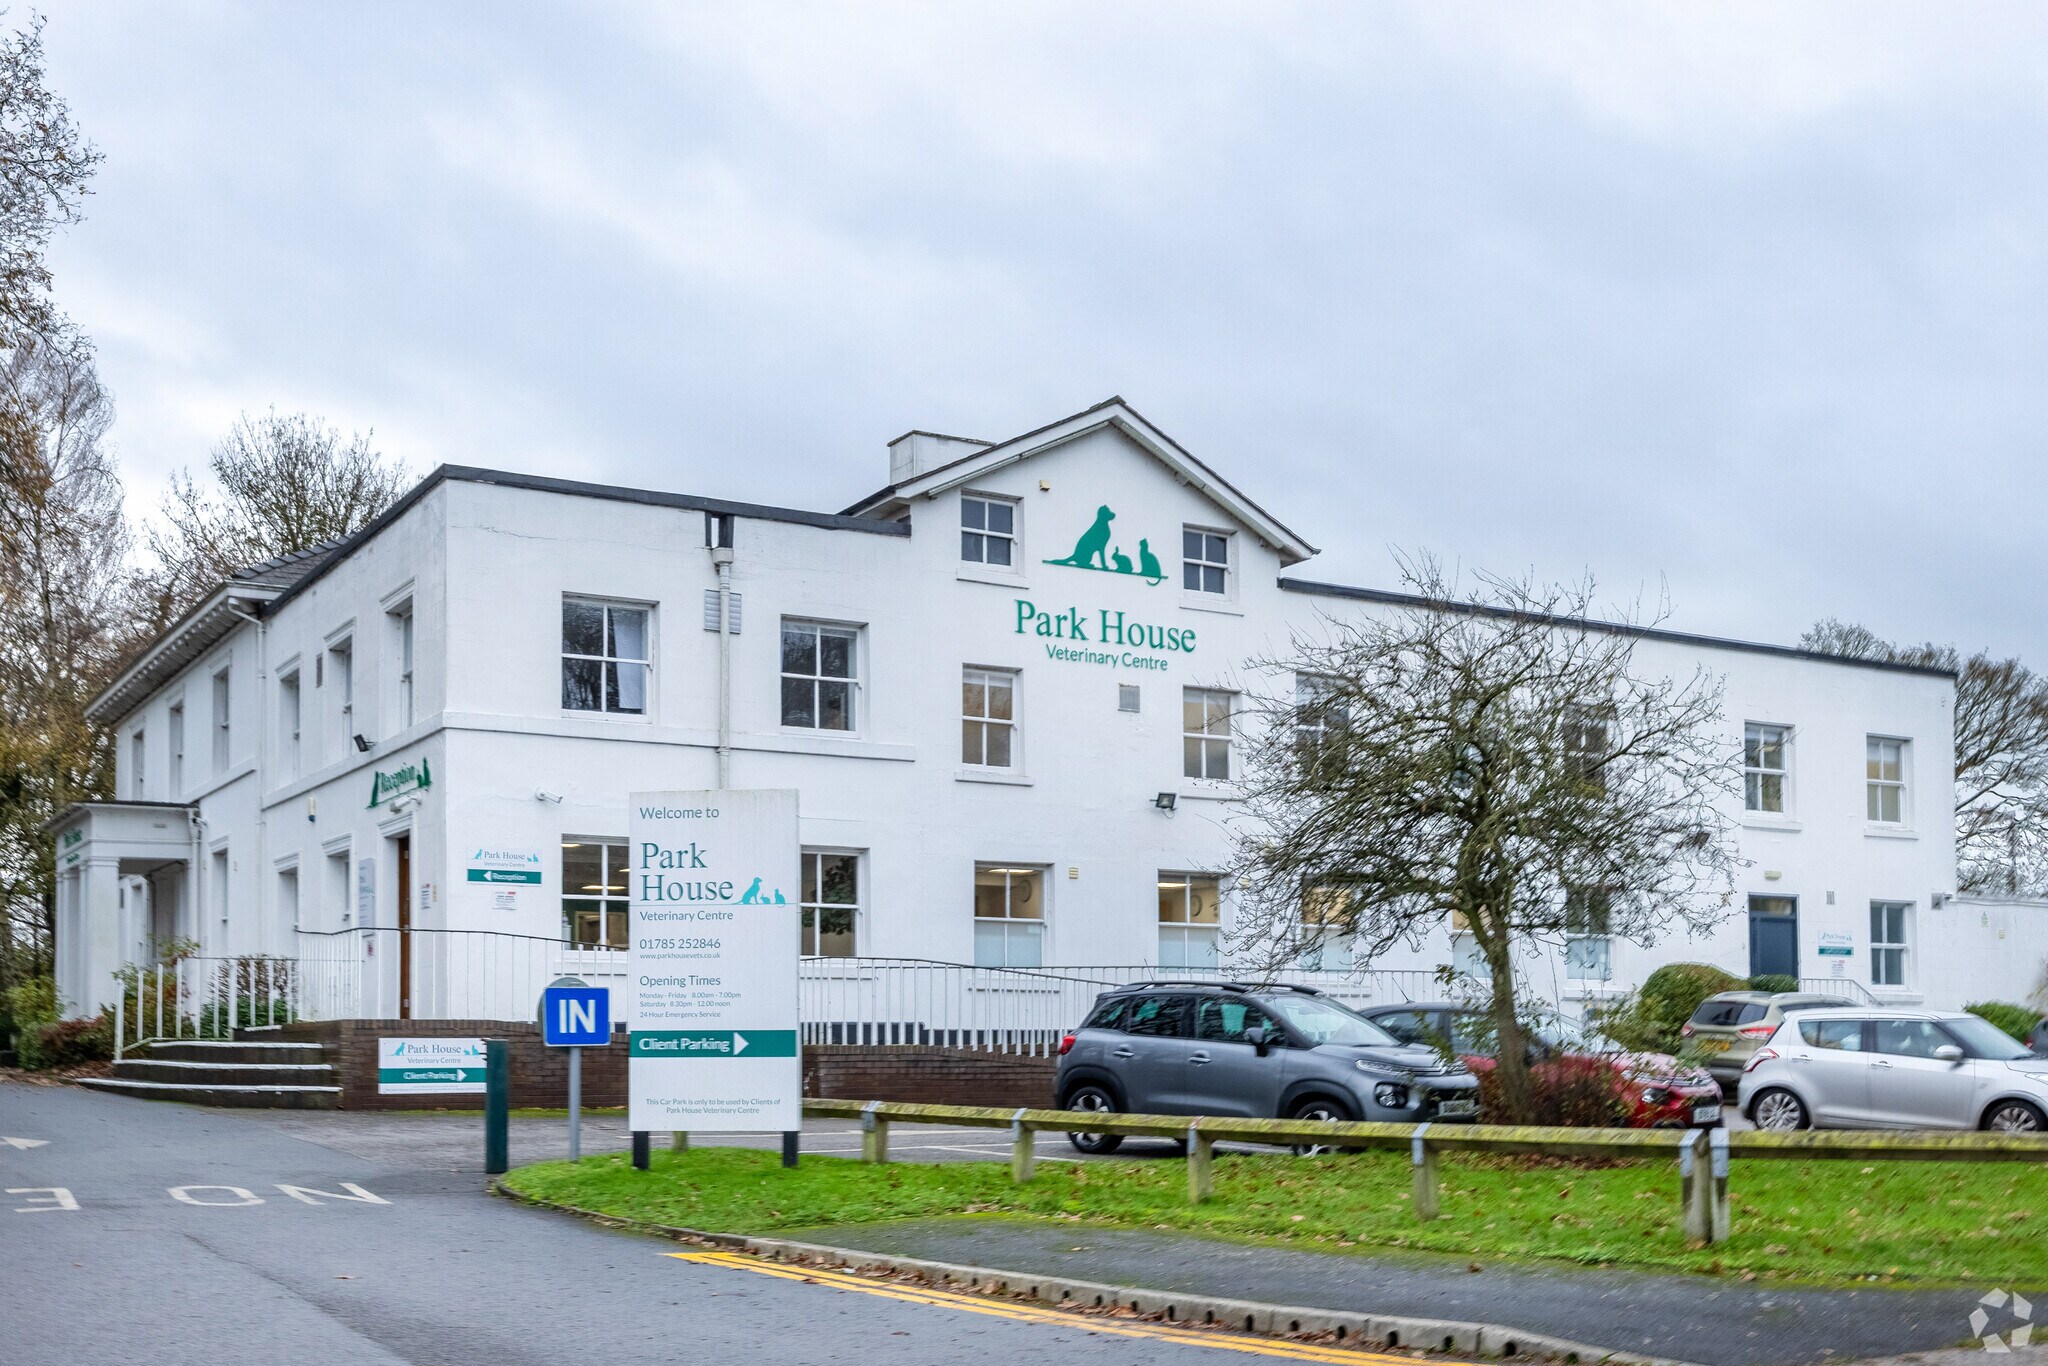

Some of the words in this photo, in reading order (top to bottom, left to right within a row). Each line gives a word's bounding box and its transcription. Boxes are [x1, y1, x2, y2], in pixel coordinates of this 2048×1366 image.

[1014, 599, 1089, 641] Park
[1099, 609, 1197, 653] House
[1046, 643, 1120, 668] Veterinary
[1121, 652, 1168, 671] Centre
[640, 807, 702, 819] Welcome
[706, 807, 720, 819] to
[484, 851, 501, 859] Park
[502, 852, 526, 860] House
[640, 842, 708, 870] Park
[640, 874, 734, 902] House
[640, 911, 695, 922] Veterinary
[697, 910, 734, 920] Centre
[640, 939, 675, 949] 01785
[678, 938, 721, 949] 252846
[640, 952, 720, 960] www.parkhousevets.co.uk
[640, 975, 686, 988] Opening
[688, 975, 721, 986] Times
[719, 991, 742, 999] 7.00pm
[559, 999, 596, 1034] IN
[407, 1045, 429, 1054] Park
[432, 1045, 462, 1054] House
[639, 1038, 679, 1050] Client
[680, 1038, 731, 1053] Parking
[694, 1098, 708, 1106] only
[741, 1098, 750, 1106] by
[703, 1107, 737, 1115] Veterinary
